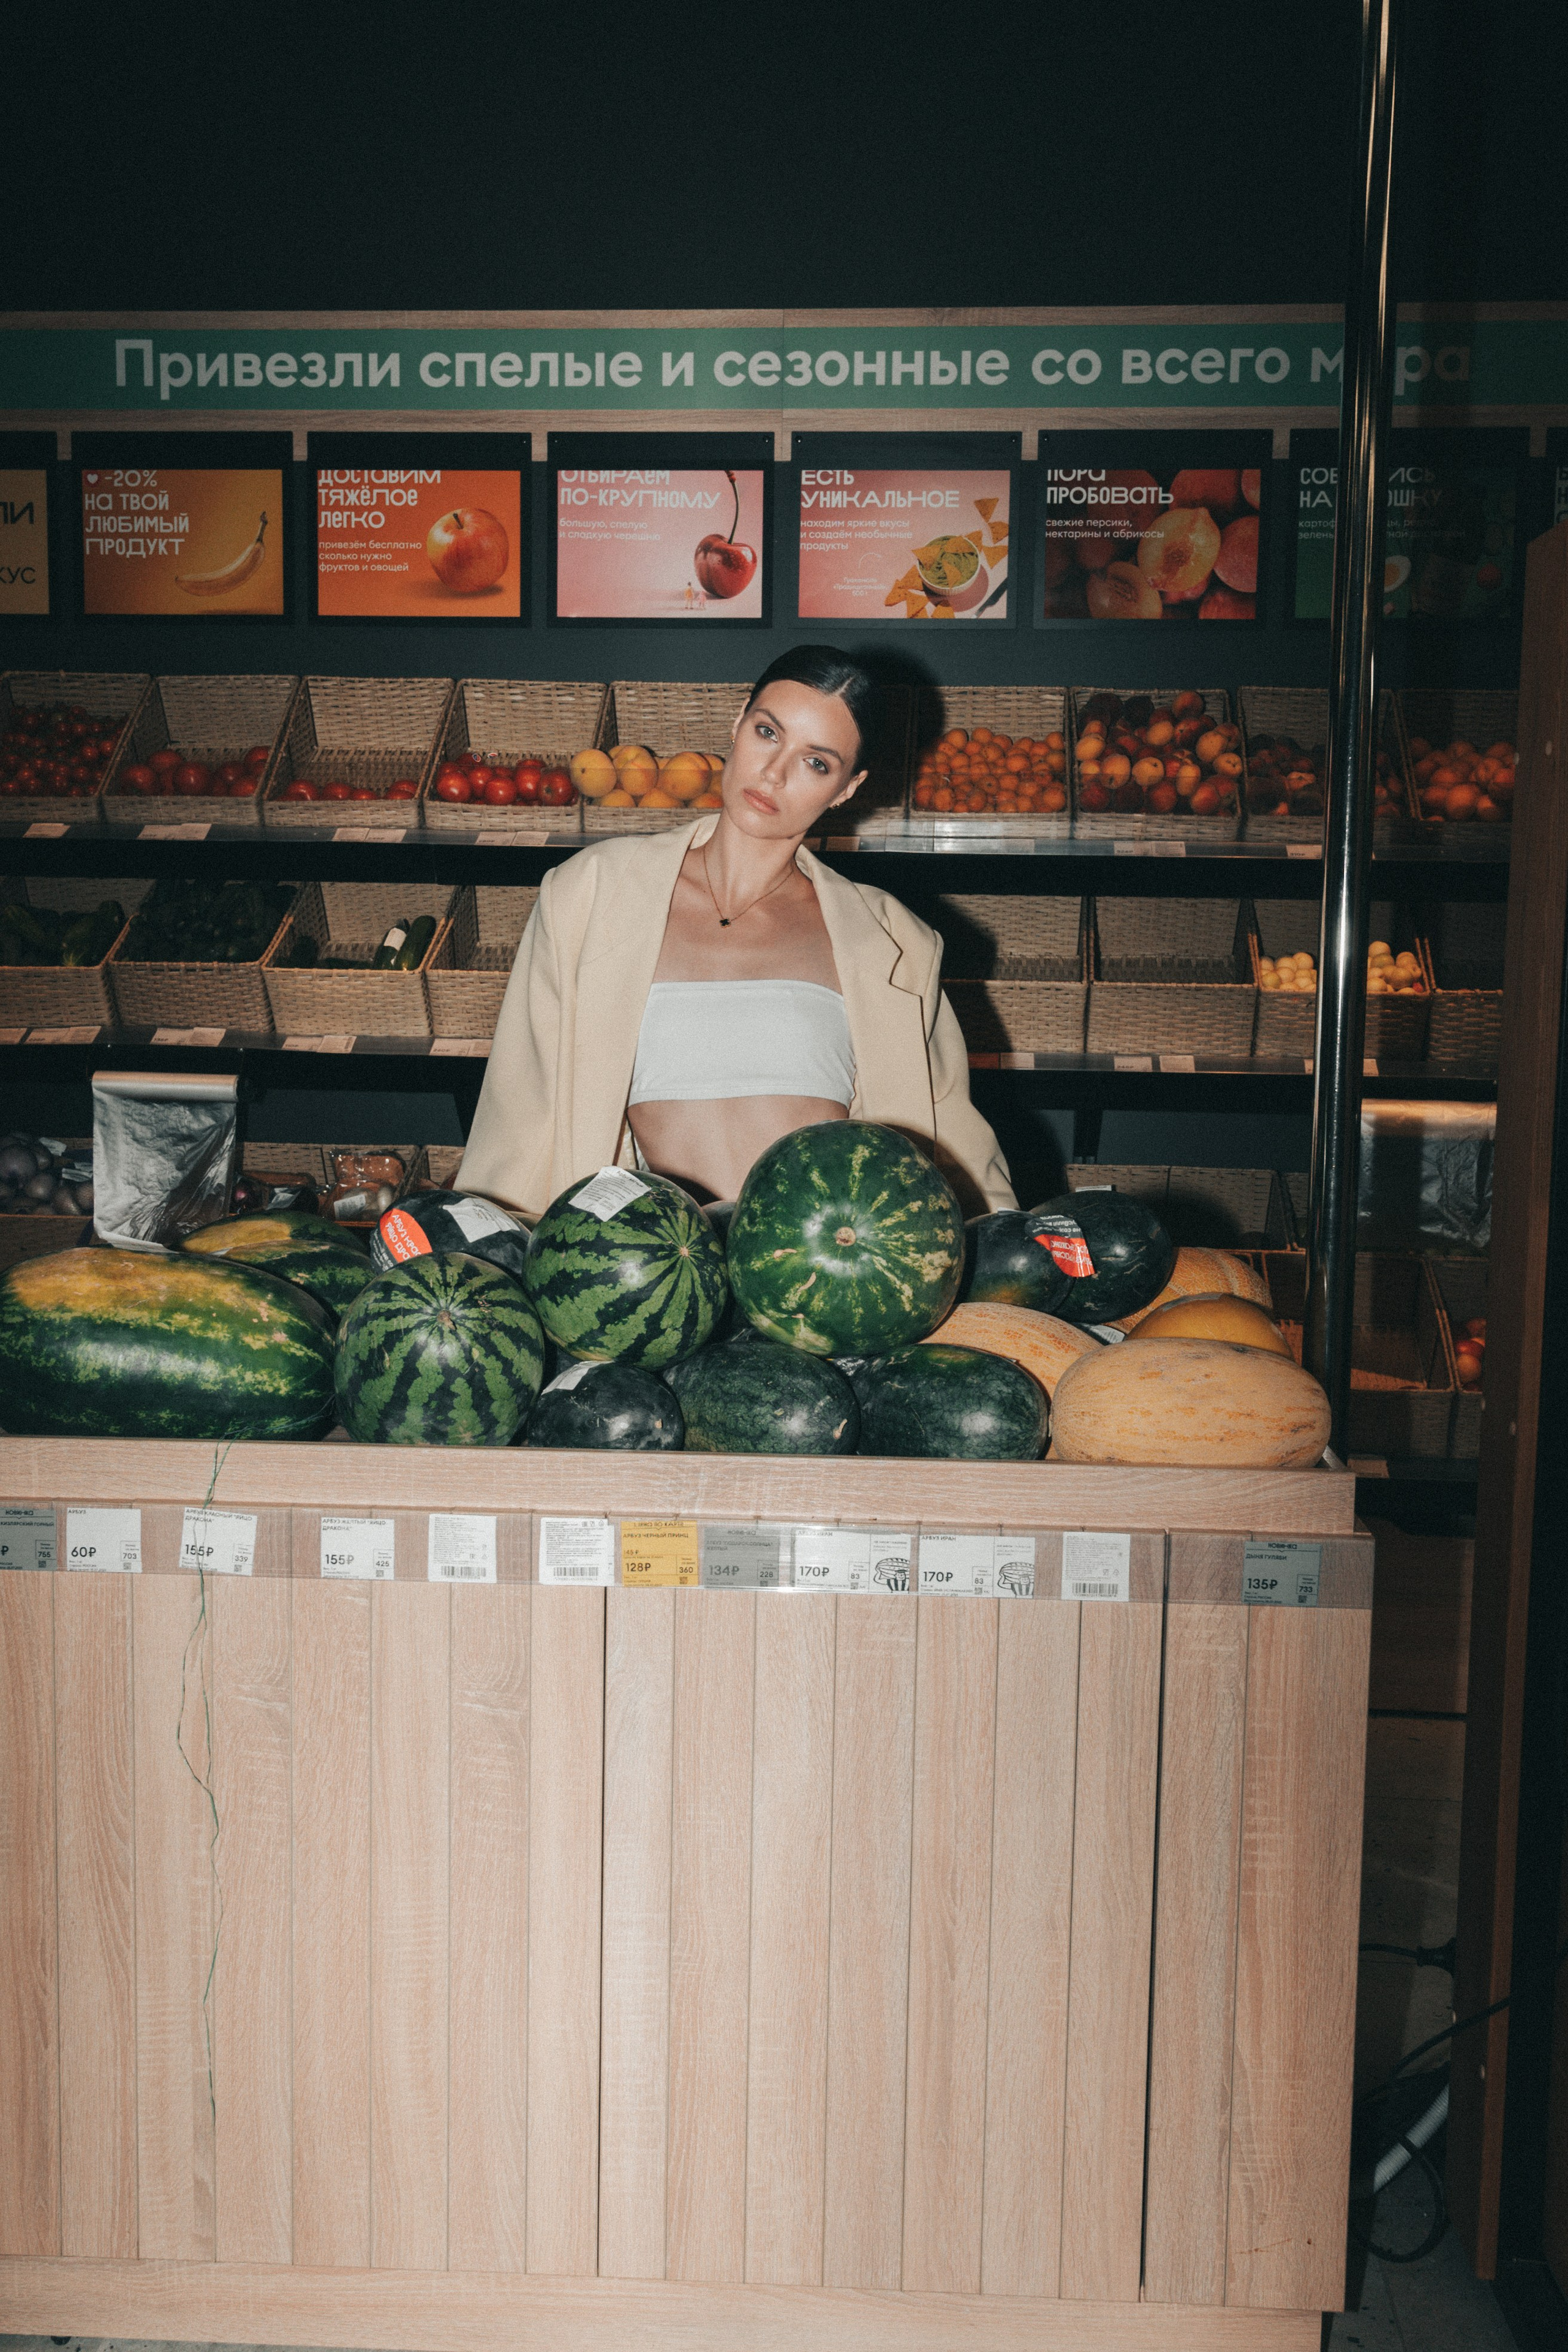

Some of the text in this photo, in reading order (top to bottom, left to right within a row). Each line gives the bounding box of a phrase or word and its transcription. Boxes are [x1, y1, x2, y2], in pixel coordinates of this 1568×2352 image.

[115, 339, 1470, 400] Привезли спелые и сезонные со всего мра
[105, 470, 157, 487] -20%
[801, 470, 854, 485] ЕСТЬ
[119, 491, 169, 510] ТВОЙ
[560, 488, 722, 509] ПО-КРУПНОМУ
[801, 490, 960, 508] УНИКАЛЬНОЕ
[1047, 487, 1174, 504] ПРОБОВАТЬ
[1299, 491, 1333, 508] НА
[85, 513, 189, 533] ЛЮБИМЫЙ
[560, 518, 648, 530] большую, спелую
[847, 520, 877, 529] яркие
[880, 520, 910, 529] вкусы
[1087, 520, 1133, 529] персики,
[568, 532, 612, 541] сладкую
[809, 530, 852, 540] создаём
[1045, 530, 1101, 540] нектарины
[1113, 529, 1164, 540] абрикосы
[85, 538, 185, 558] ПРОДУКТ
[319, 540, 422, 551] привезём бесплатно
[800, 542, 848, 551] продукты
[360, 553, 392, 562] нужно
[319, 562, 360, 573] фруктов
[371, 562, 409, 573] овощей
[385, 1222, 398, 1242] ЯЙЦО
[392, 1215, 421, 1256] АРБУЗ КРАС
